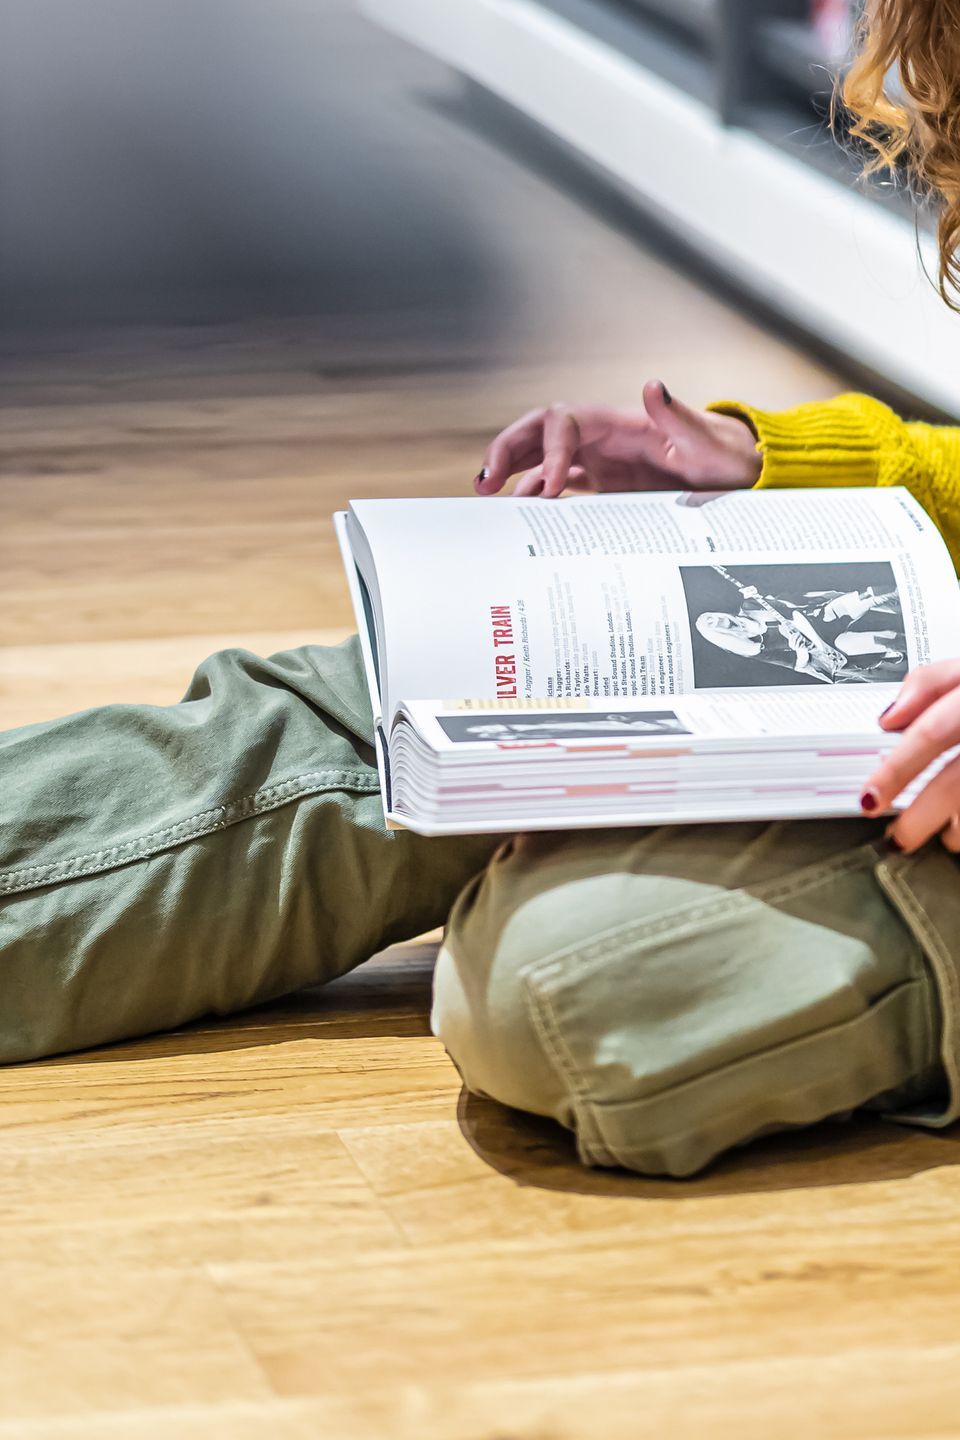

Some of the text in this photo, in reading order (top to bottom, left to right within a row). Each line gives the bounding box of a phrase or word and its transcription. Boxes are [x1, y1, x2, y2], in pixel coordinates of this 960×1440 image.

[490, 606, 517, 699] ILVER TRAIN
[519, 617, 532, 692] Jagger Keith Richards
[610, 659, 618, 680] Sound
[639, 656, 647, 674] Team
[657, 652, 666, 685] engineer:
[666, 654, 674, 675] sound
[574, 668, 582, 691] Taylor:
